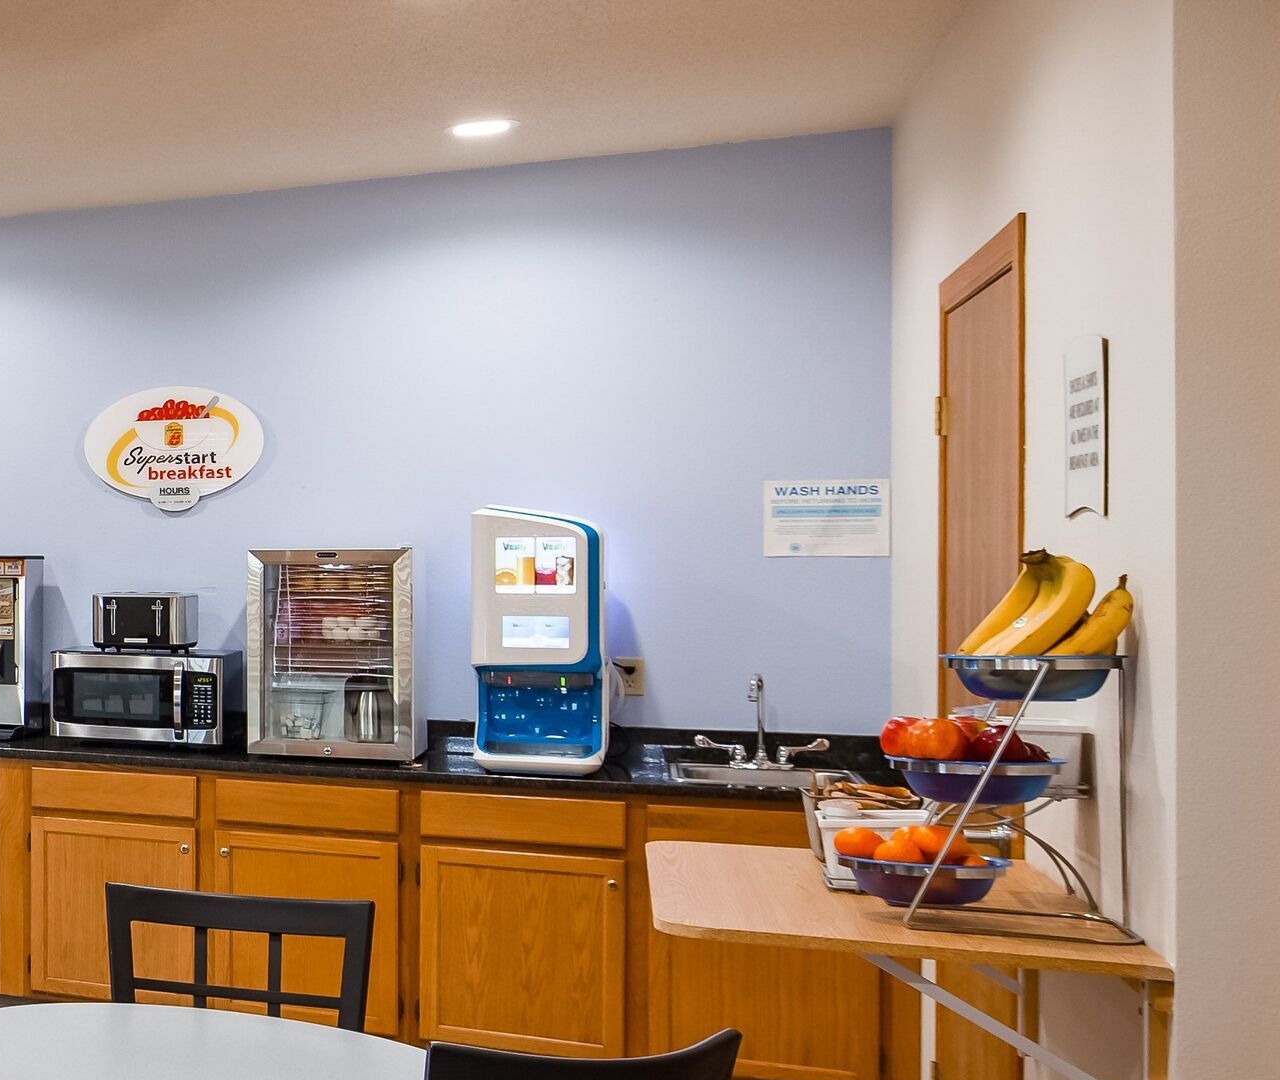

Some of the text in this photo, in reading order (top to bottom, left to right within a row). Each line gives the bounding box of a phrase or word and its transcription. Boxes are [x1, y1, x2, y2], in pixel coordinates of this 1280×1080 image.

[124, 446, 217, 475] Superstart
[148, 465, 232, 481] breakfast
[774, 485, 880, 496] WASH HANDS
